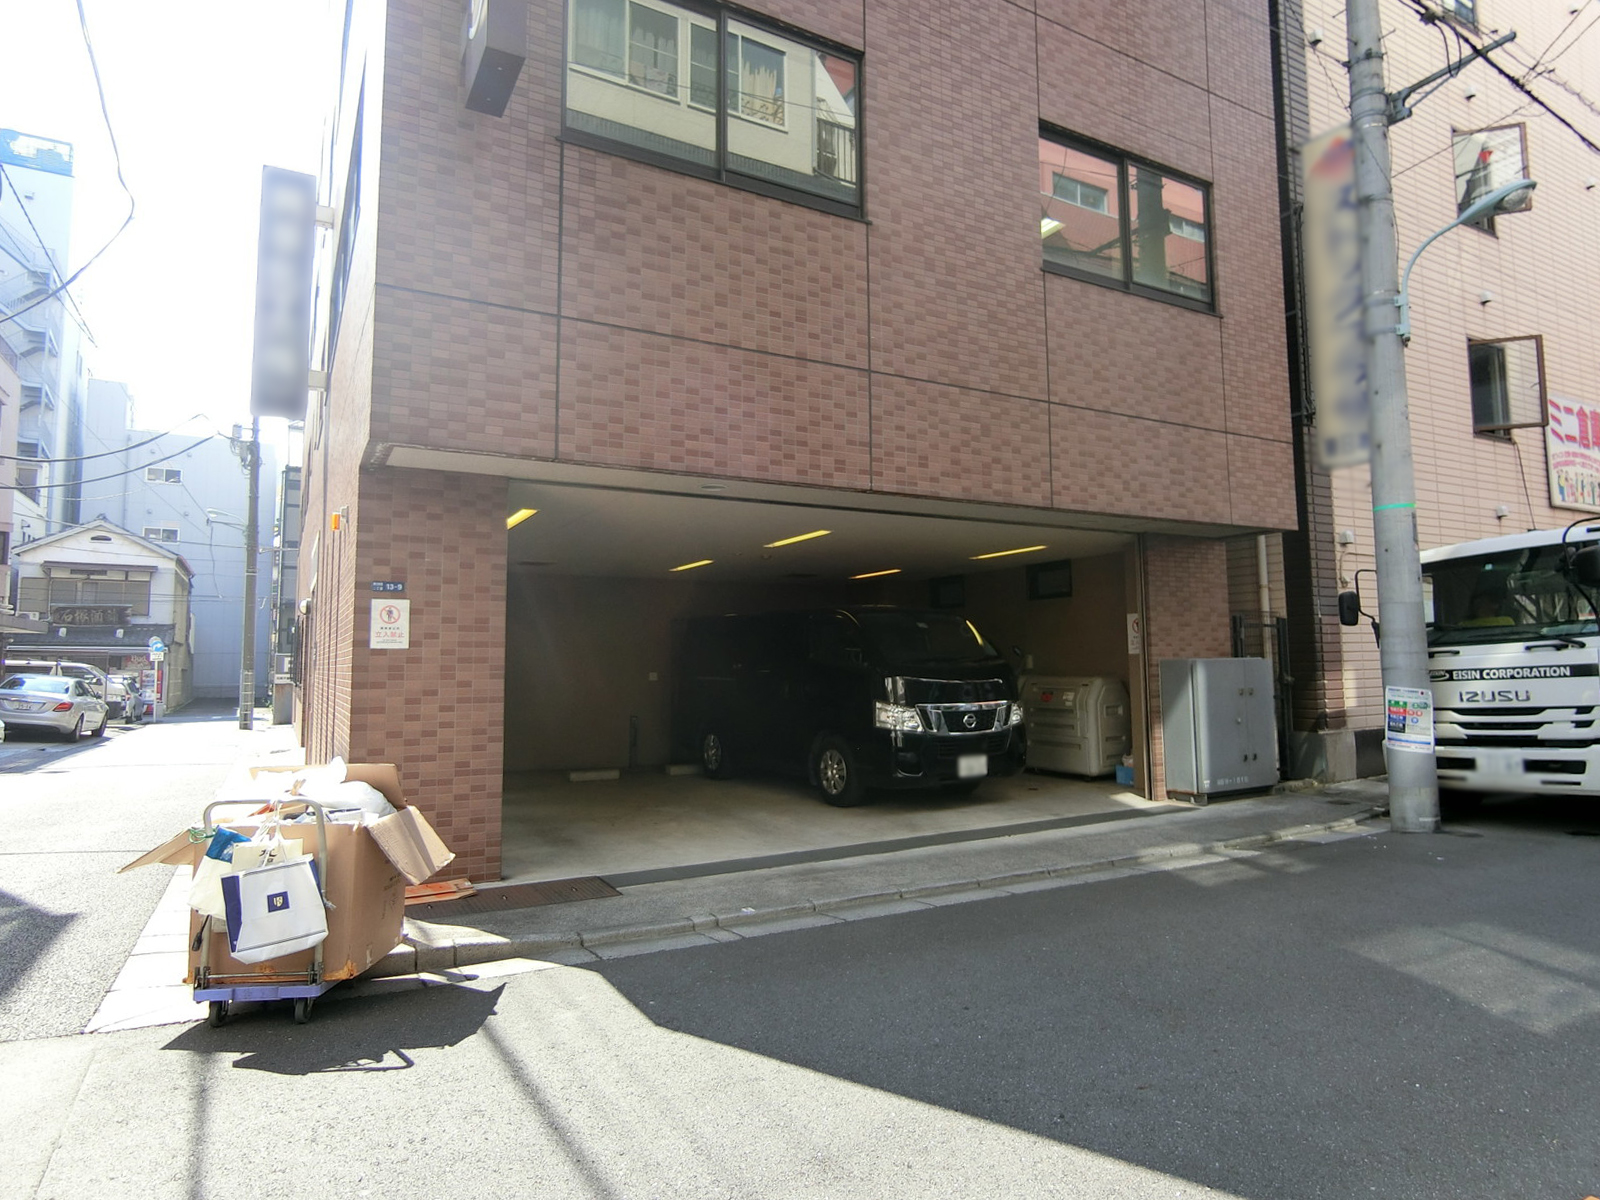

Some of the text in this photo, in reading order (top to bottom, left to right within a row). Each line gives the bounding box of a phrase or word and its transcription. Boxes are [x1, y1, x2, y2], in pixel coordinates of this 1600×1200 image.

[386, 583, 403, 591] 13-9
[1452, 670, 1480, 680] EISIN
[1482, 666, 1571, 680] CORPORATION
